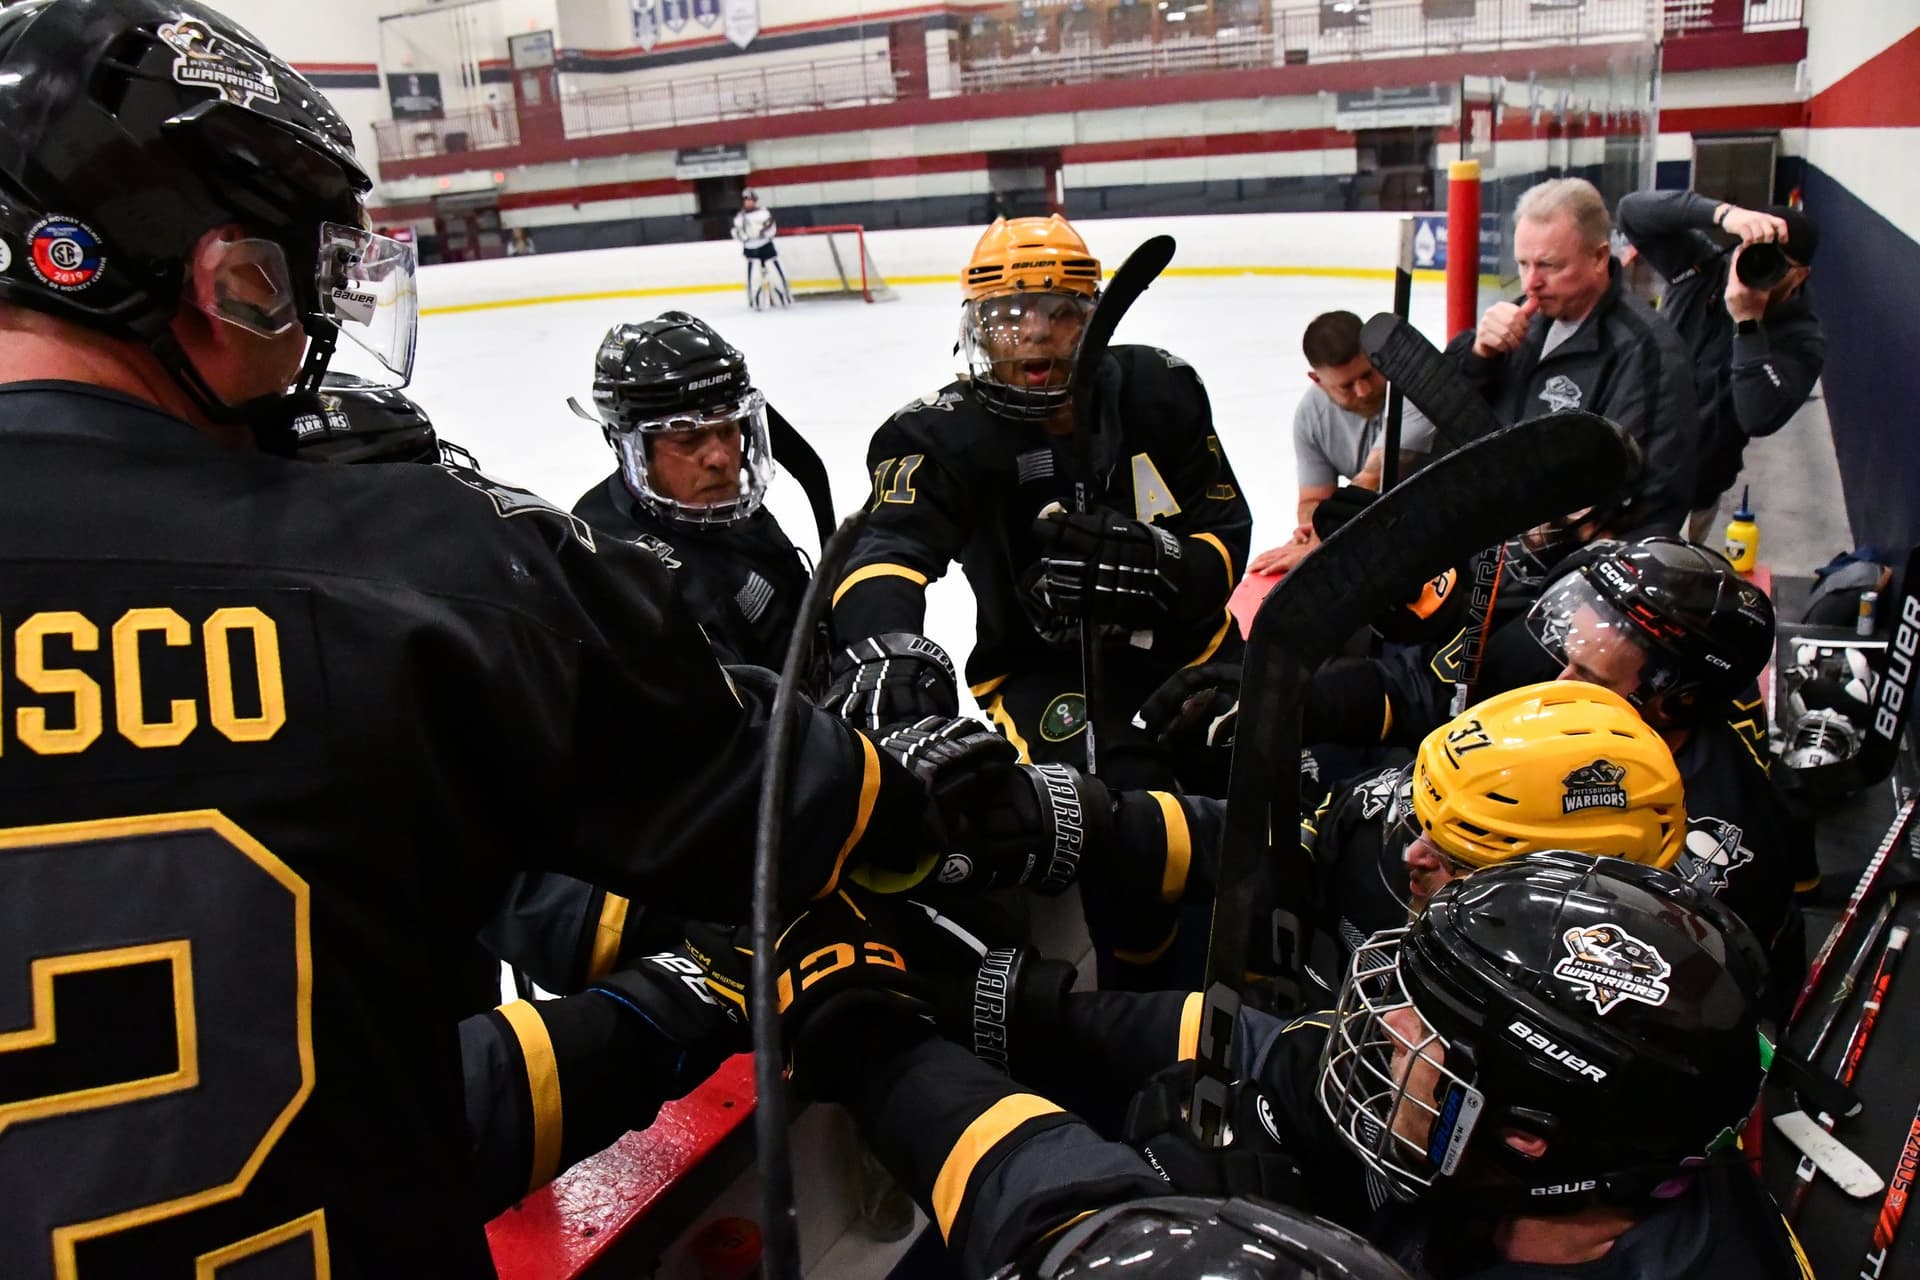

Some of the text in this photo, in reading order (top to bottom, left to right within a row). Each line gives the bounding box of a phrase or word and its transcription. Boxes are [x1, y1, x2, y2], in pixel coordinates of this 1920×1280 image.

[181, 66, 275, 97] WARRIORS
[53, 271, 84, 282] 2019
[1011, 260, 1057, 270] BAUER
[333, 290, 375, 304] BAUER
[688, 372, 732, 391] BAUER
[1131, 452, 1182, 524] A
[1599, 561, 1637, 593] CCM
[1704, 653, 1732, 671] CCM
[1874, 594, 1920, 740] BAUER
[0, 607, 287, 757] SCO
[1448, 719, 1493, 756] 37
[1420, 763, 1442, 802] CCM
[1572, 785, 1616, 795] PITTSBURGH
[1565, 793, 1626, 813] WARRIORS
[1032, 763, 1083, 888] WARRIO
[777, 942, 907, 1015] CC
[1561, 964, 1662, 1000] WARRIORS
[1574, 959, 1652, 986] PITTSBURGH
[1508, 1021, 1607, 1082] BAUER
[1531, 1180, 1611, 1196] BAUE
